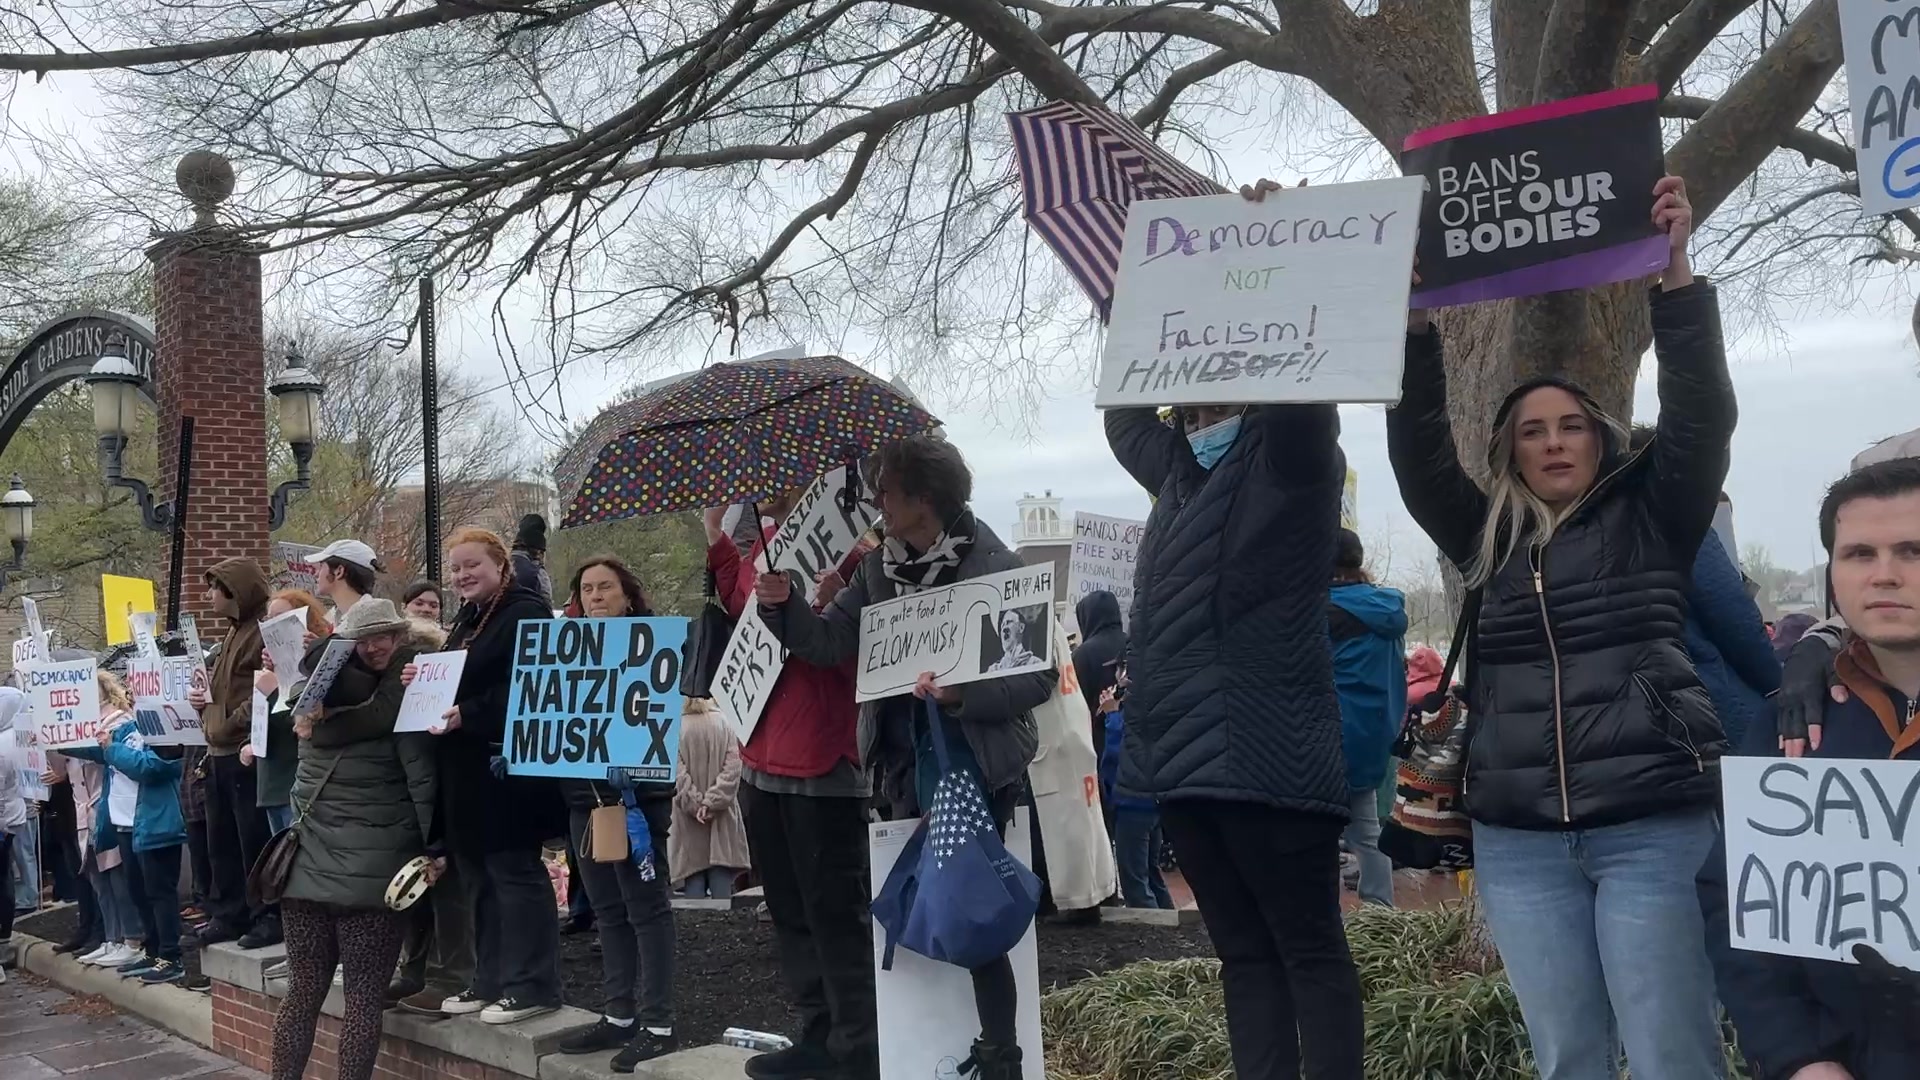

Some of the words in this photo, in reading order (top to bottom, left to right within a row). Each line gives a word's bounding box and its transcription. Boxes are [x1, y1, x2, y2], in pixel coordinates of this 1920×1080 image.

[1438, 150, 1541, 197] BANS
[1438, 187, 1513, 227] OFF
[1518, 171, 1616, 213] OUR
[1139, 210, 1397, 267] Democracy
[1444, 205, 1600, 258] BODIES
[1223, 266, 1286, 291] NOT
[37, 327, 103, 372] GARDENS
[1158, 304, 1318, 352] Facism!
[1076, 520, 1120, 541] HANDS
[1076, 542, 1106, 559] FREE
[889, 603, 913, 634] quite
[916, 601, 936, 620] fond
[938, 588, 956, 616] of
[517, 620, 606, 667] ELON
[720, 616, 755, 694] RATIFY
[866, 630, 914, 674] ELON
[913, 620, 958, 657] MUSK
[31, 666, 93, 687] DEMOCRACY
[418, 662, 450, 682] FUCK
[50, 688, 80, 706] DIES
[56, 709, 73, 722] IN
[41, 720, 98, 745] SILENCE
[510, 717, 613, 765] MUSK
[1735, 852, 1920, 951] AMER
